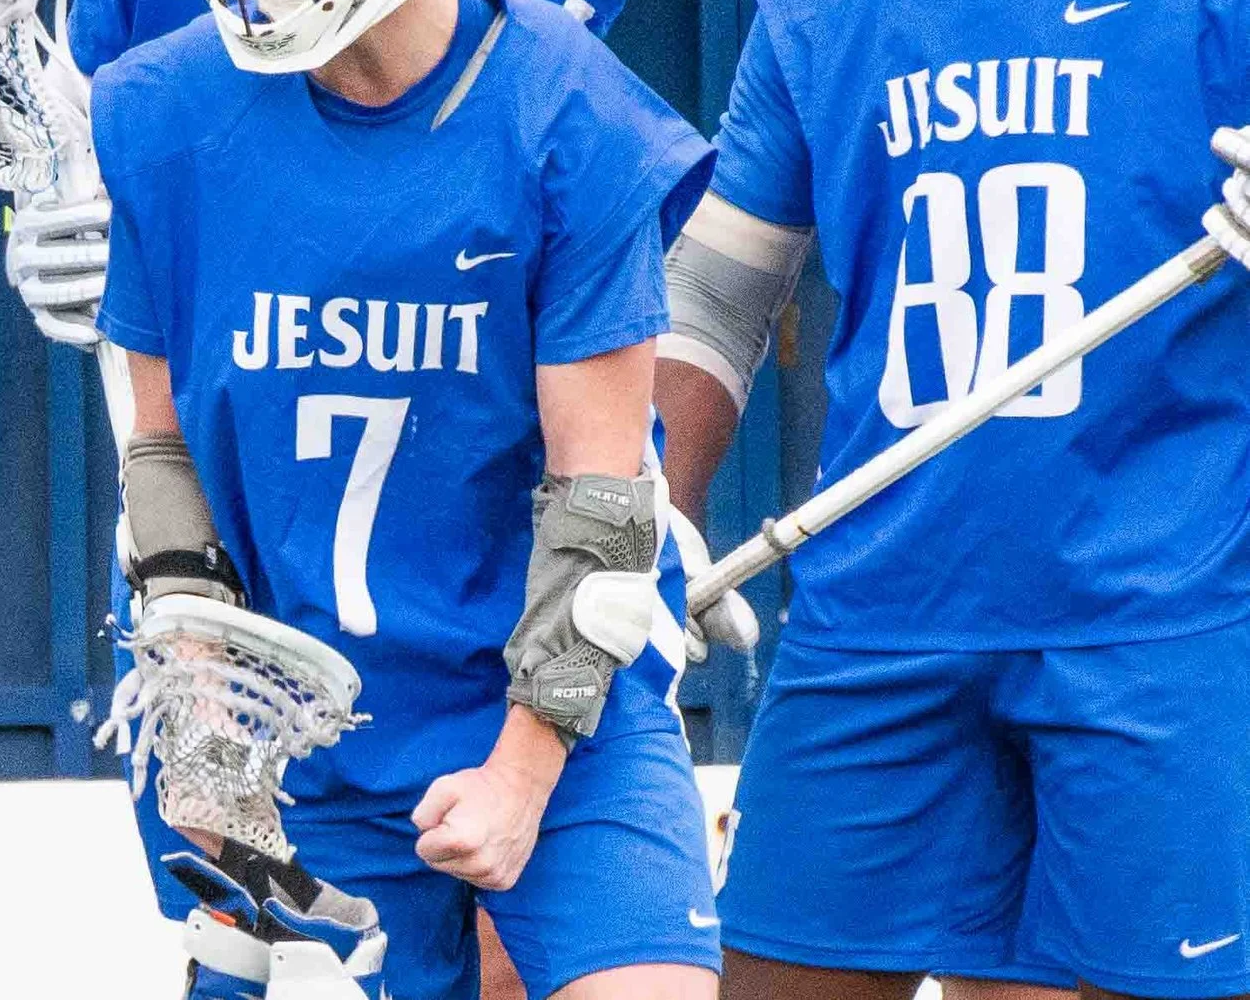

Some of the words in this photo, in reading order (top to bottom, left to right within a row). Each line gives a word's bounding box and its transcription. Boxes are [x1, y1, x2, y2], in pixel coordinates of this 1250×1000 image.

[232, 291, 489, 375] JESUIT
[878, 162, 1086, 430] 88
[296, 394, 411, 637] 7
